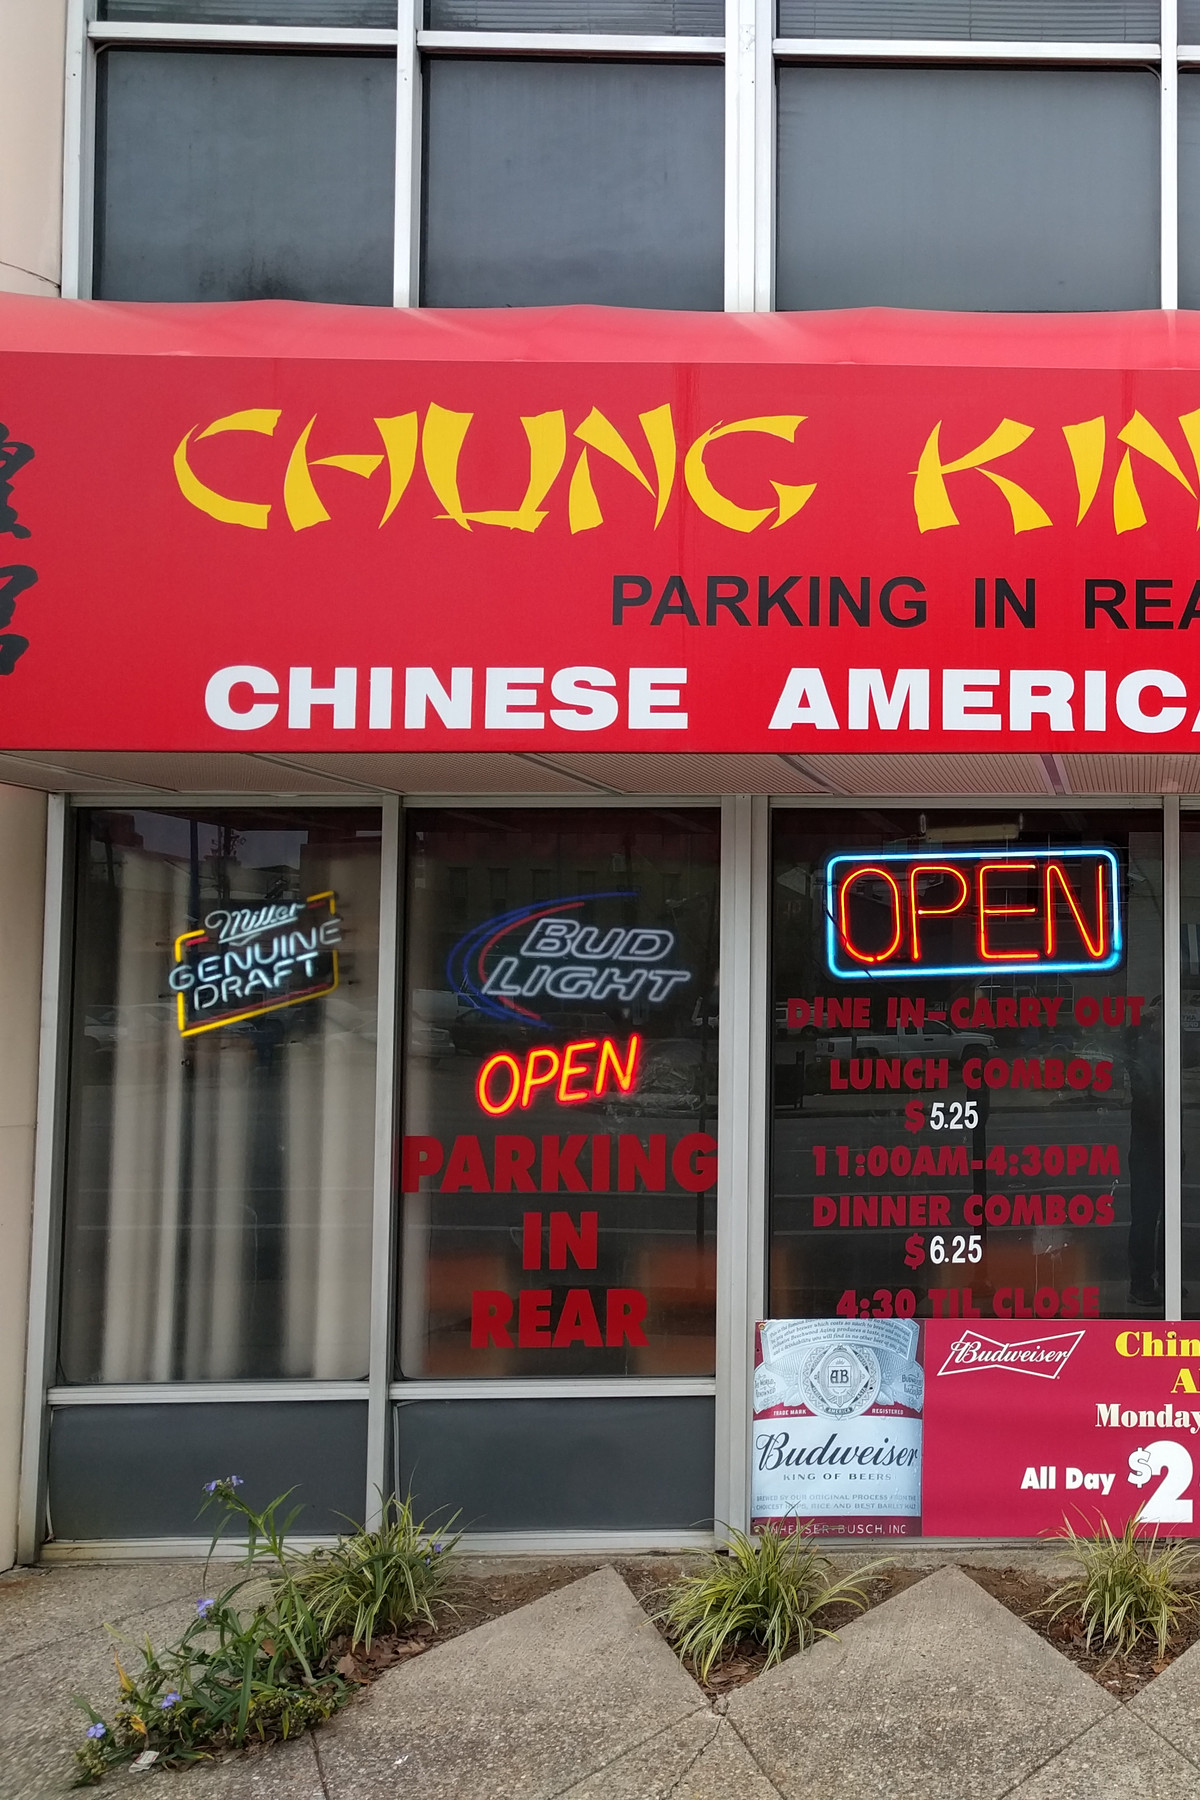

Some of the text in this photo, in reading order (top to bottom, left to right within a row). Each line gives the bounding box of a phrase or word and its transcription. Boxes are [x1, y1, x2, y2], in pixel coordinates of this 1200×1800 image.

[173, 402, 817, 534] CHUNG
[613, 576, 926, 628] PARKING
[975, 578, 1036, 628] IN
[204, 666, 689, 730] CHINESE
[205, 903, 306, 944] Miller
[840, 859, 1105, 964] OPEN
[169, 918, 342, 990] GENUINE
[520, 917, 675, 962] BUD
[193, 951, 319, 1011] DRAFT
[481, 956, 692, 1002] LIGHT
[787, 996, 1145, 1029] DINE IN-CARRY OUT
[476, 1034, 641, 1117] OPEN
[830, 1058, 1114, 1091] LUNCH COMBOS
[402, 1133, 718, 1193] PARKING
[812, 1145, 1121, 1177] 11:00AM-4:30PM
[813, 1194, 1115, 1227] DINNER COMBOS
[522, 1212, 598, 1269] IN
[471, 1288, 650, 1348] REAR
[836, 1286, 1100, 1319] 4:30 TIL CLOSE
[950, 1341, 1070, 1364] Budweiser
[830, 1370, 849, 1384] AB
[755, 1431, 919, 1472] Budweiser
[1020, 1466, 1057, 1490] All
[1065, 1467, 1117, 1496] Day
[888, 1524, 907, 1534] INC
